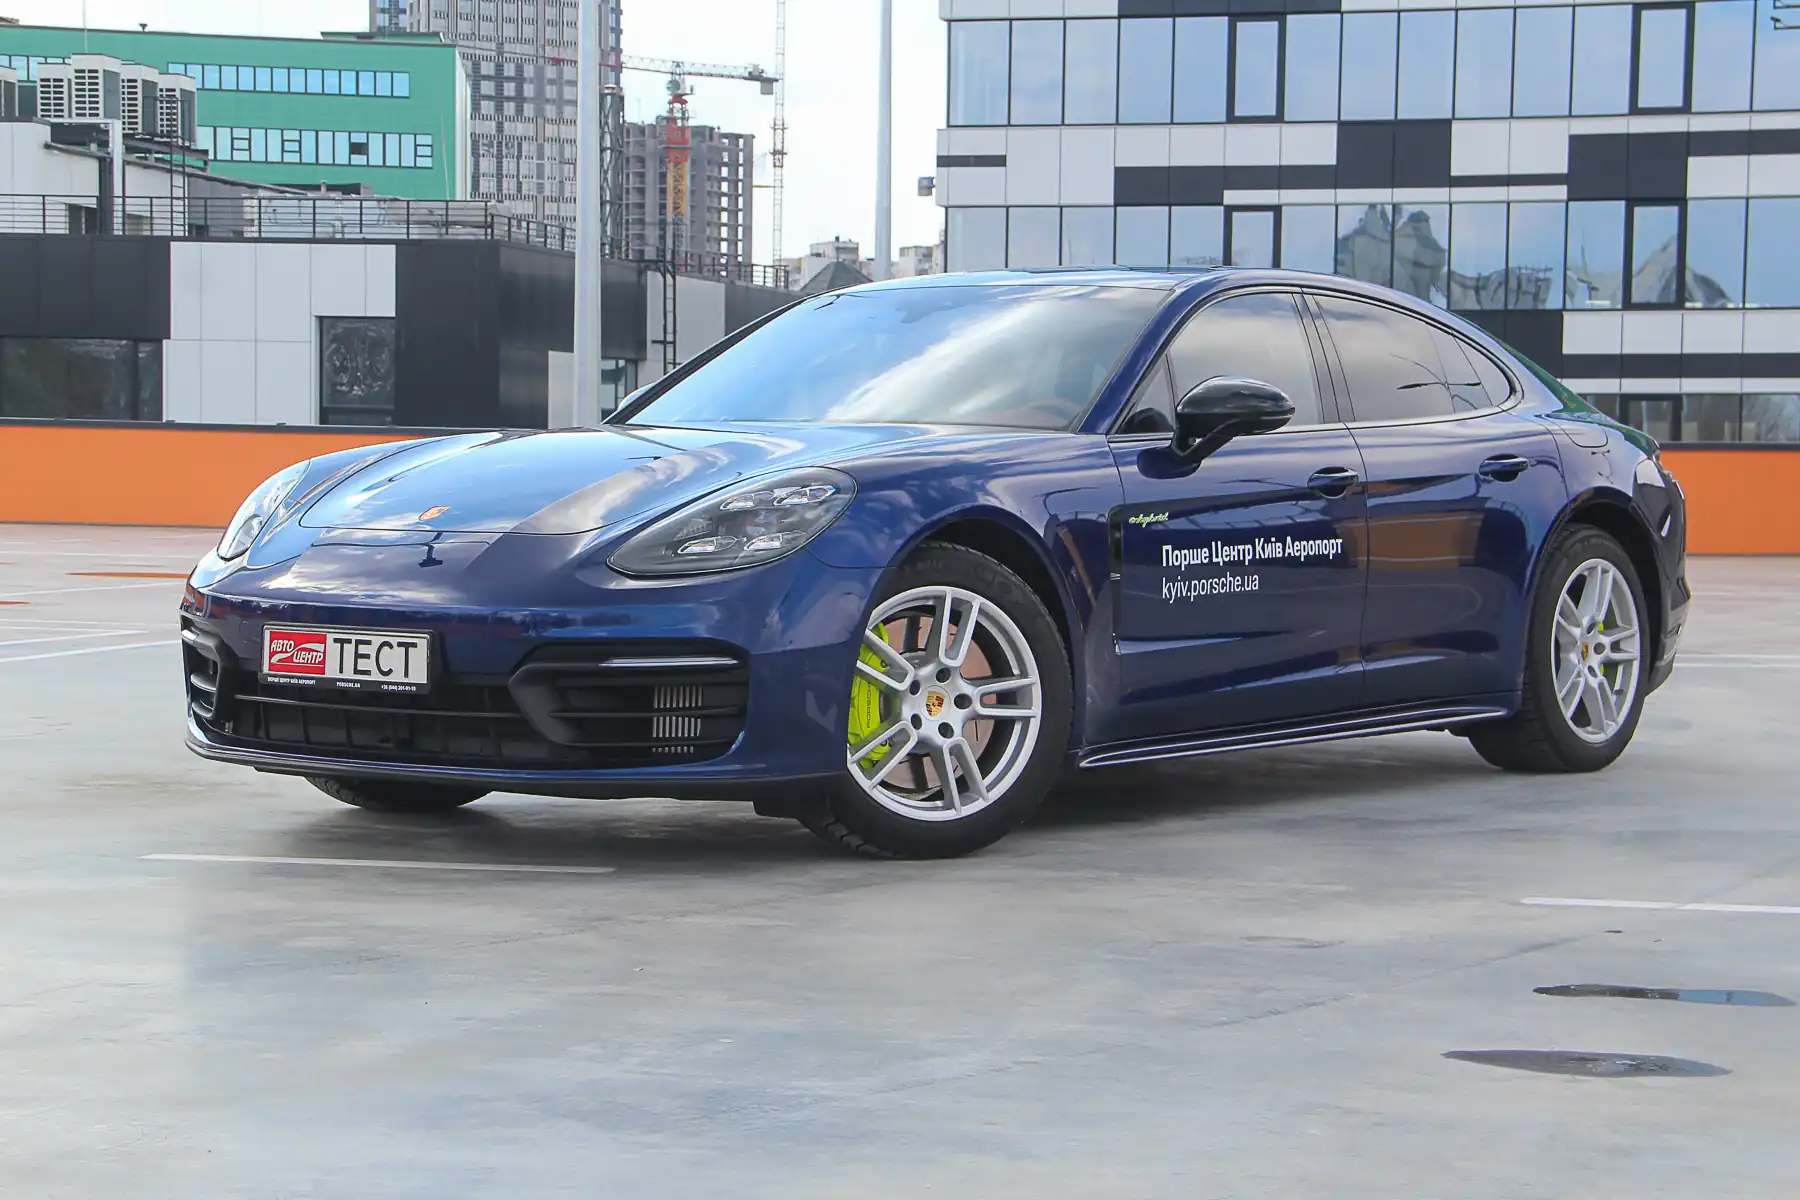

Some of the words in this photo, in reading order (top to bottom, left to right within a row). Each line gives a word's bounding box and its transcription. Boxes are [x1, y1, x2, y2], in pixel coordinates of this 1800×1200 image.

[1162, 545, 1209, 571] Порше
[1211, 540, 1253, 566] Центр
[1255, 537, 1283, 559] Київ
[1284, 535, 1343, 561] Аеропорт
[1162, 571, 1259, 604] kyiv.porsche.ua
[270, 639, 296, 652] АВТО
[293, 651, 324, 664] ЦЕНТР
[333, 638, 417, 678] ТЕСТ
